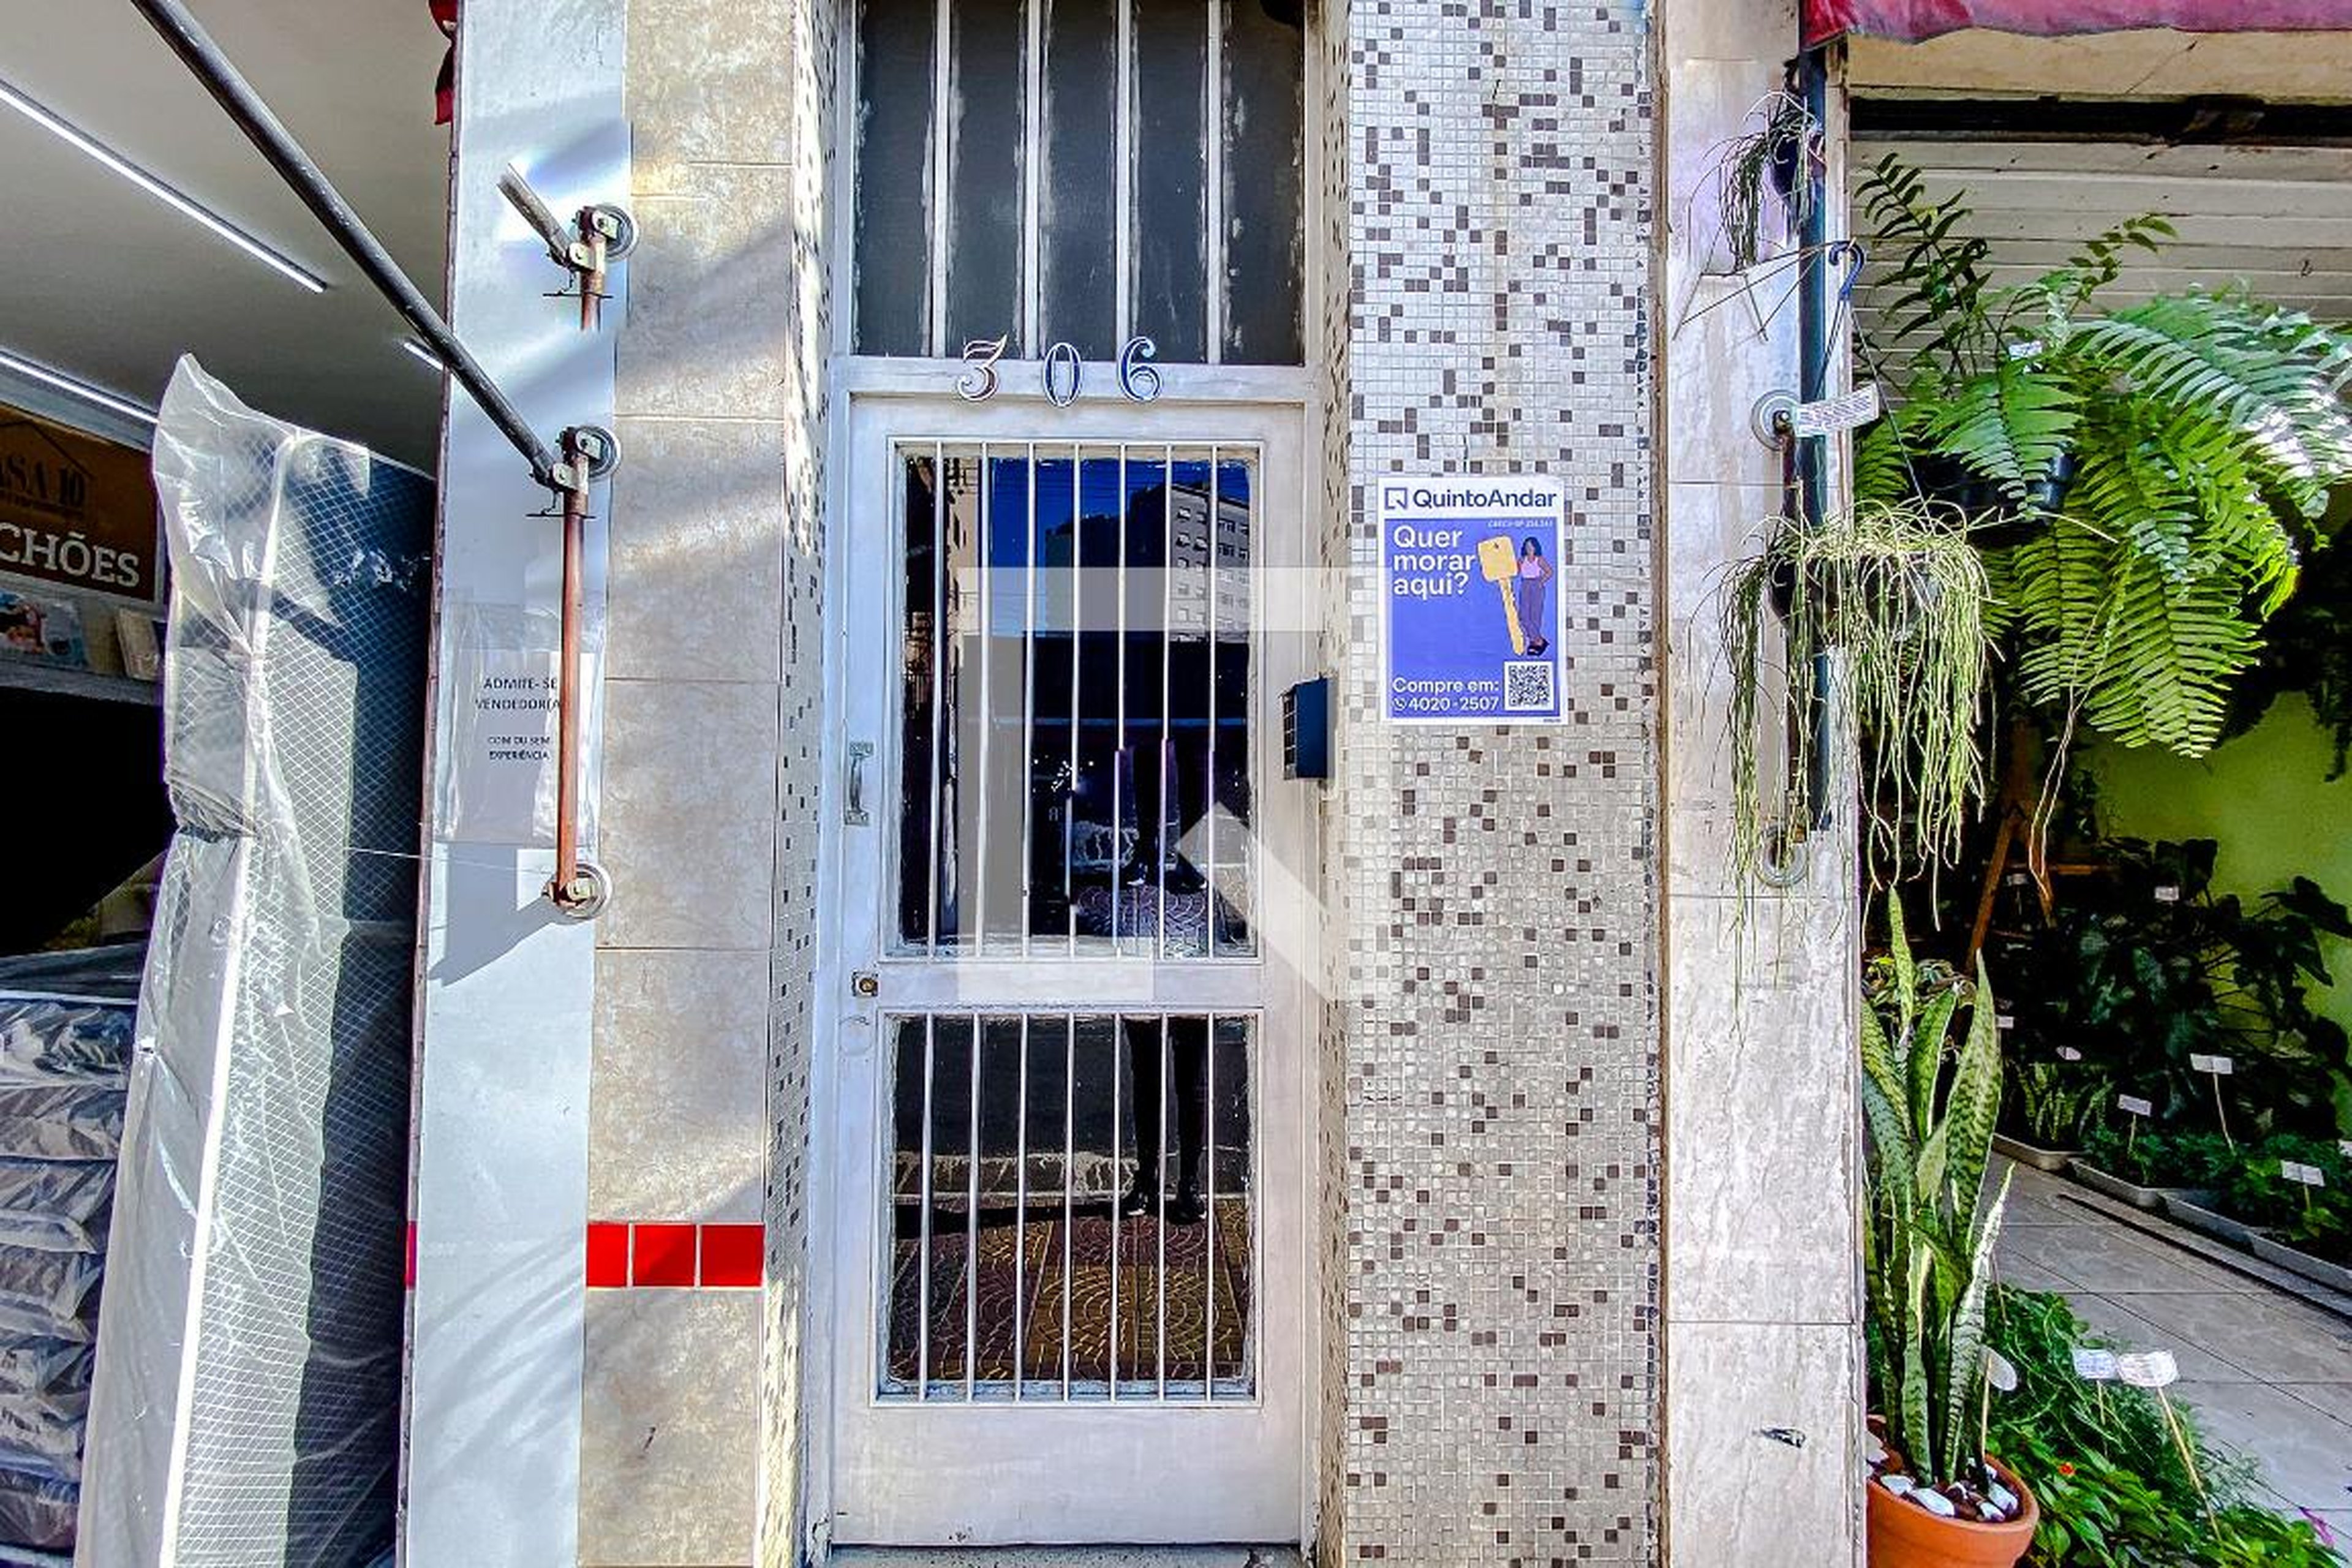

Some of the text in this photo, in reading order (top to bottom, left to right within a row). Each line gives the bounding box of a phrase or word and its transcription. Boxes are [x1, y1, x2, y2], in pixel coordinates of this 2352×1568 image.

[1412, 488, 1557, 509] QuintoAndar
[1393, 525, 1463, 548] Quer
[1393, 554, 1476, 571] morar
[1393, 572, 1469, 600] aqui?
[1392, 677, 1499, 695] Compre em:
[475, 698, 560, 712] VENDEDOR(A
